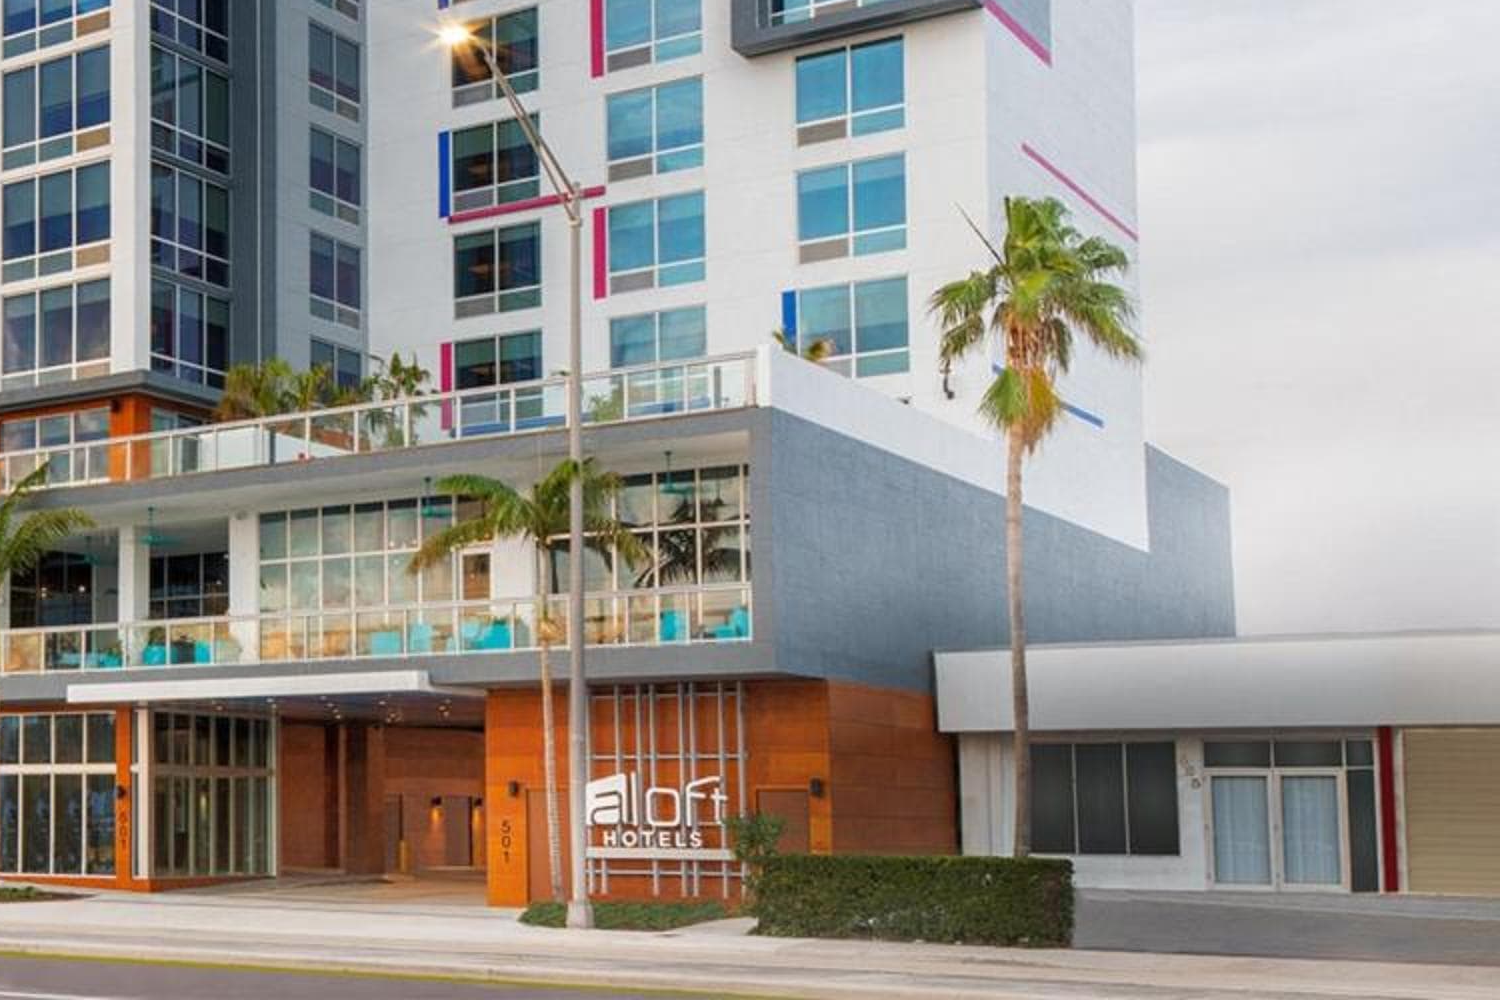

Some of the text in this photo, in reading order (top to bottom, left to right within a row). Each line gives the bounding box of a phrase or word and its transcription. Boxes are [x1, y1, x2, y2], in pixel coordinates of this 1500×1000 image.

[586, 771, 728, 827] aloft
[501, 820, 511, 864] 501
[603, 830, 703, 847] HOTELS
